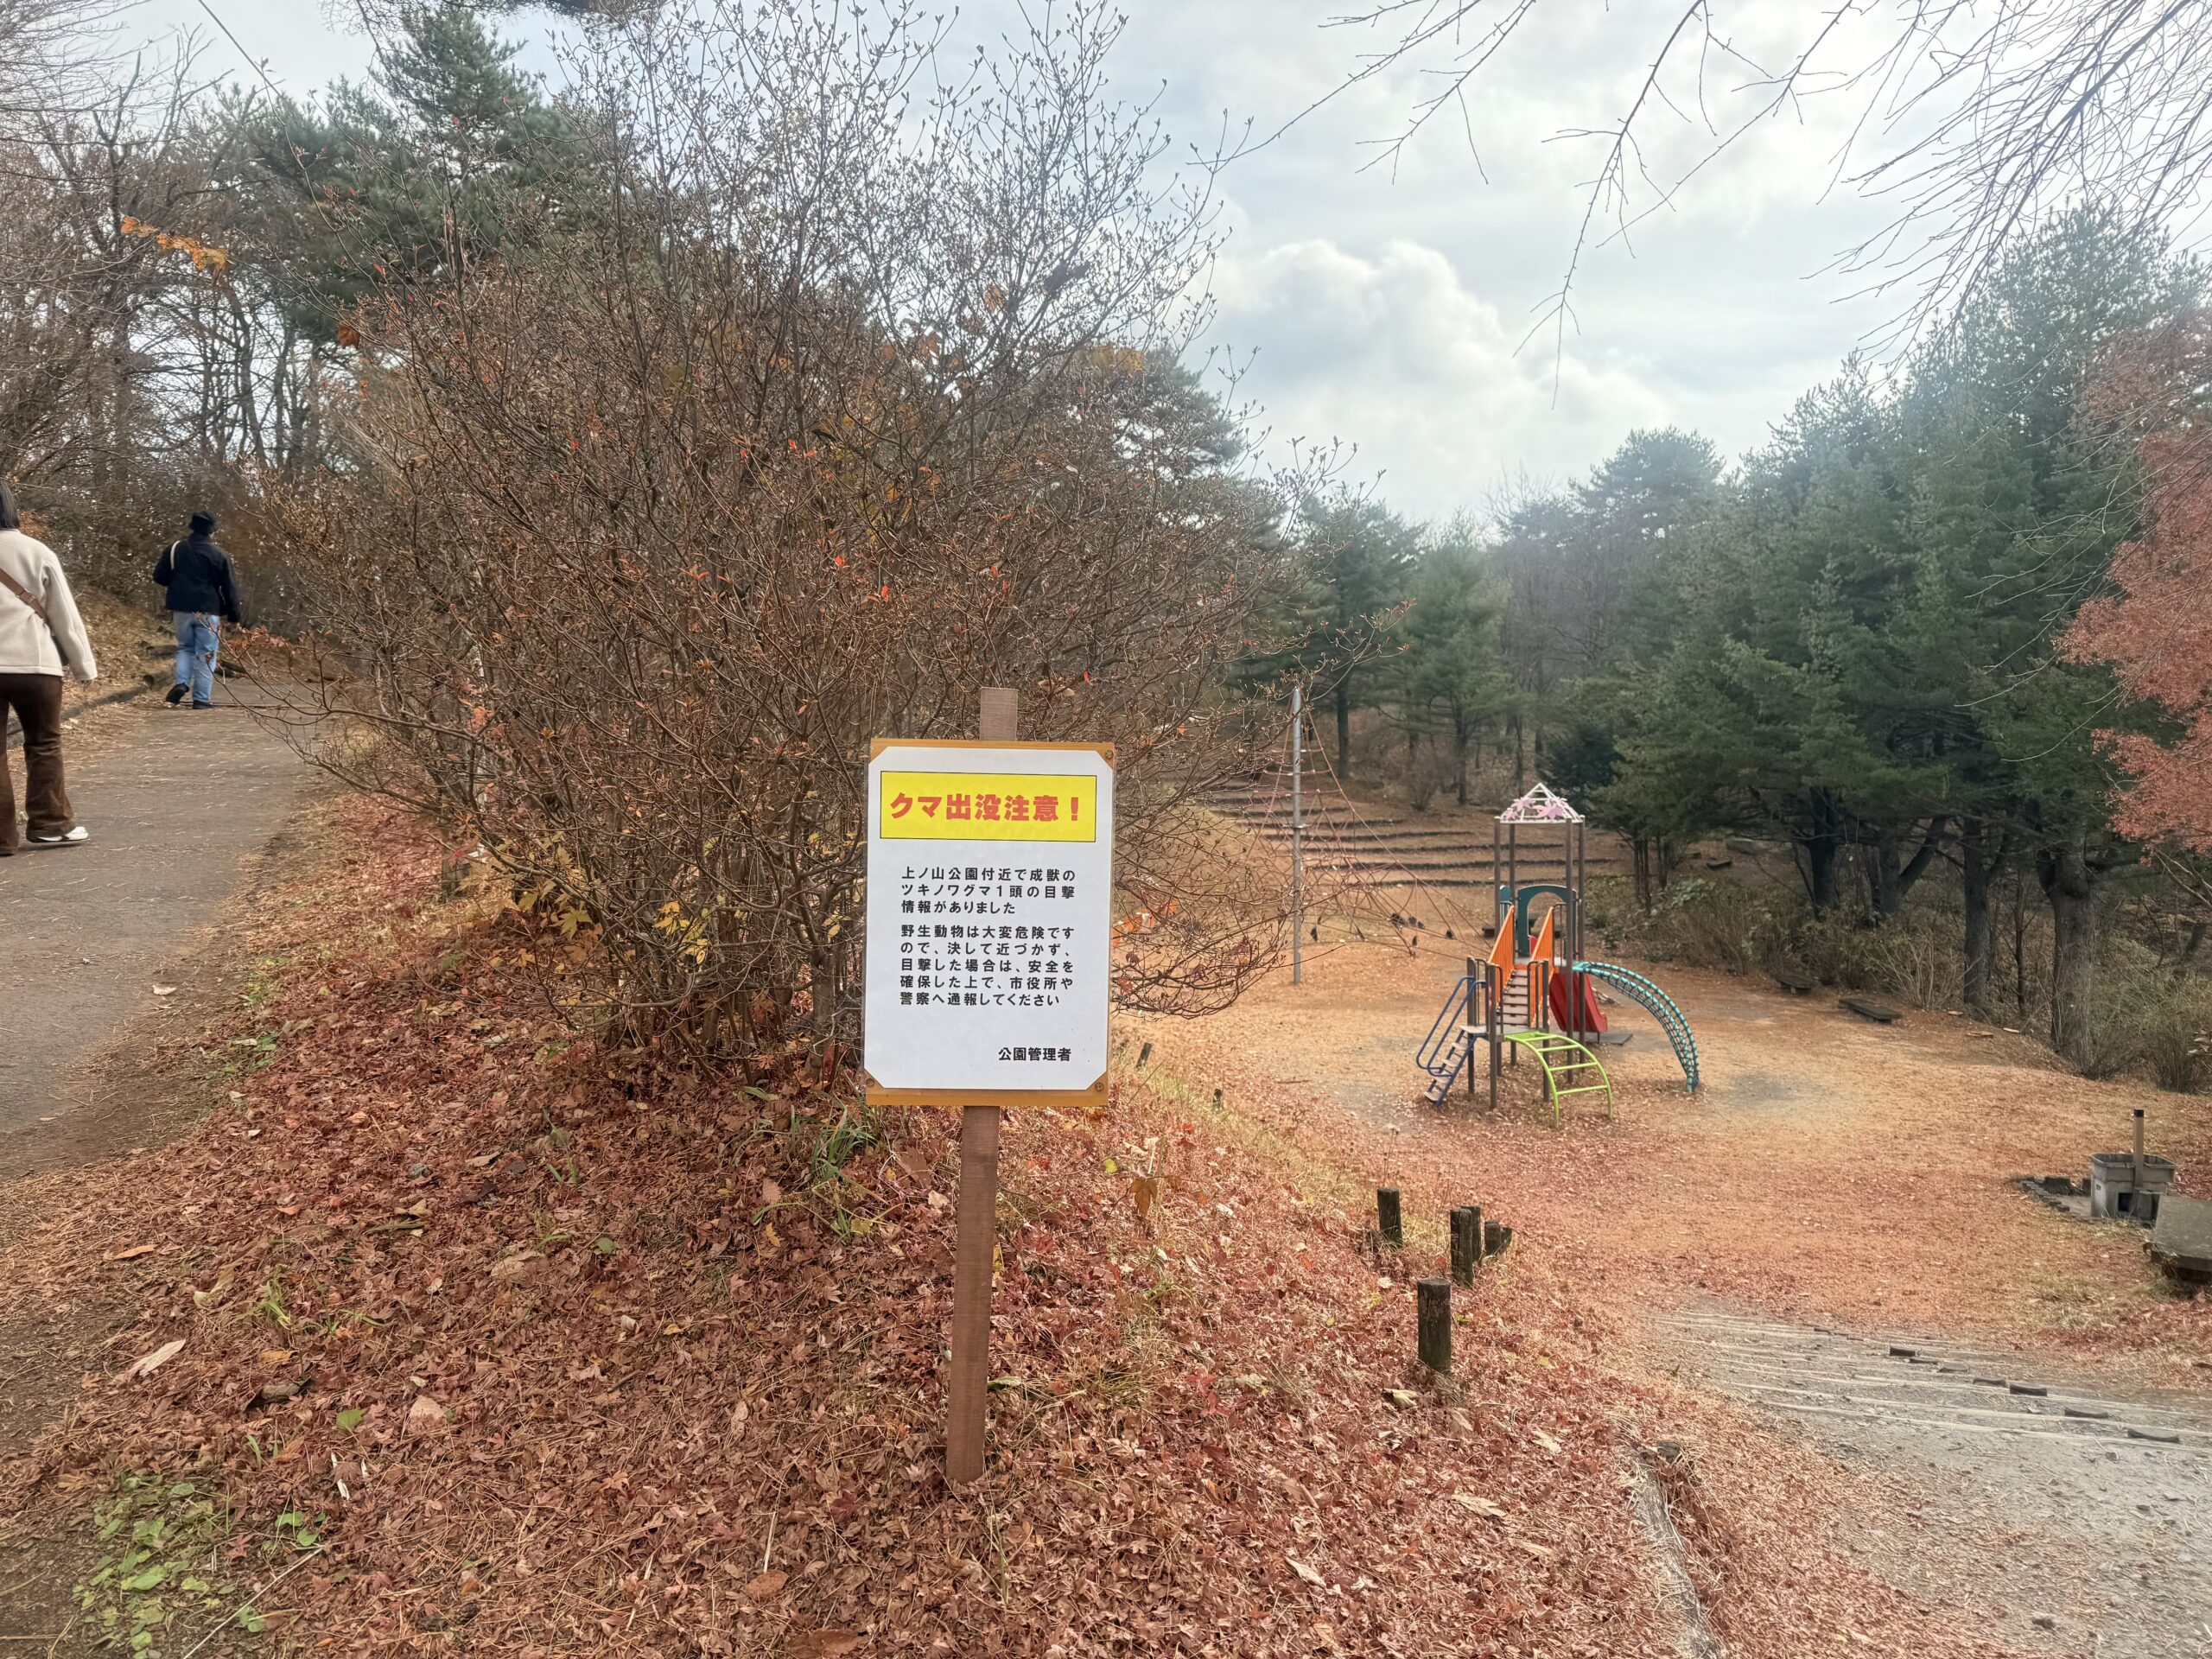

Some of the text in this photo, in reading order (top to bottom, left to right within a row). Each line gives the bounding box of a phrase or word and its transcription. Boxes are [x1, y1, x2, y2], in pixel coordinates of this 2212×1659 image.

[901, 866, 1076, 881] 上ノ山公園付近で成獣の
[900, 899, 1015, 914] 情報がありました
[900, 925, 1075, 939] 野生動物は大変危険です
[900, 942, 1071, 956] ので、決して近づかず、
[901, 958, 1073, 973] 目撃した場合は、安全を
[899, 975, 1073, 989] 確保した上で、市役所や
[899, 991, 1059, 1006] 警察へ通報してください
[998, 1046, 1071, 1062] 公園管理者
